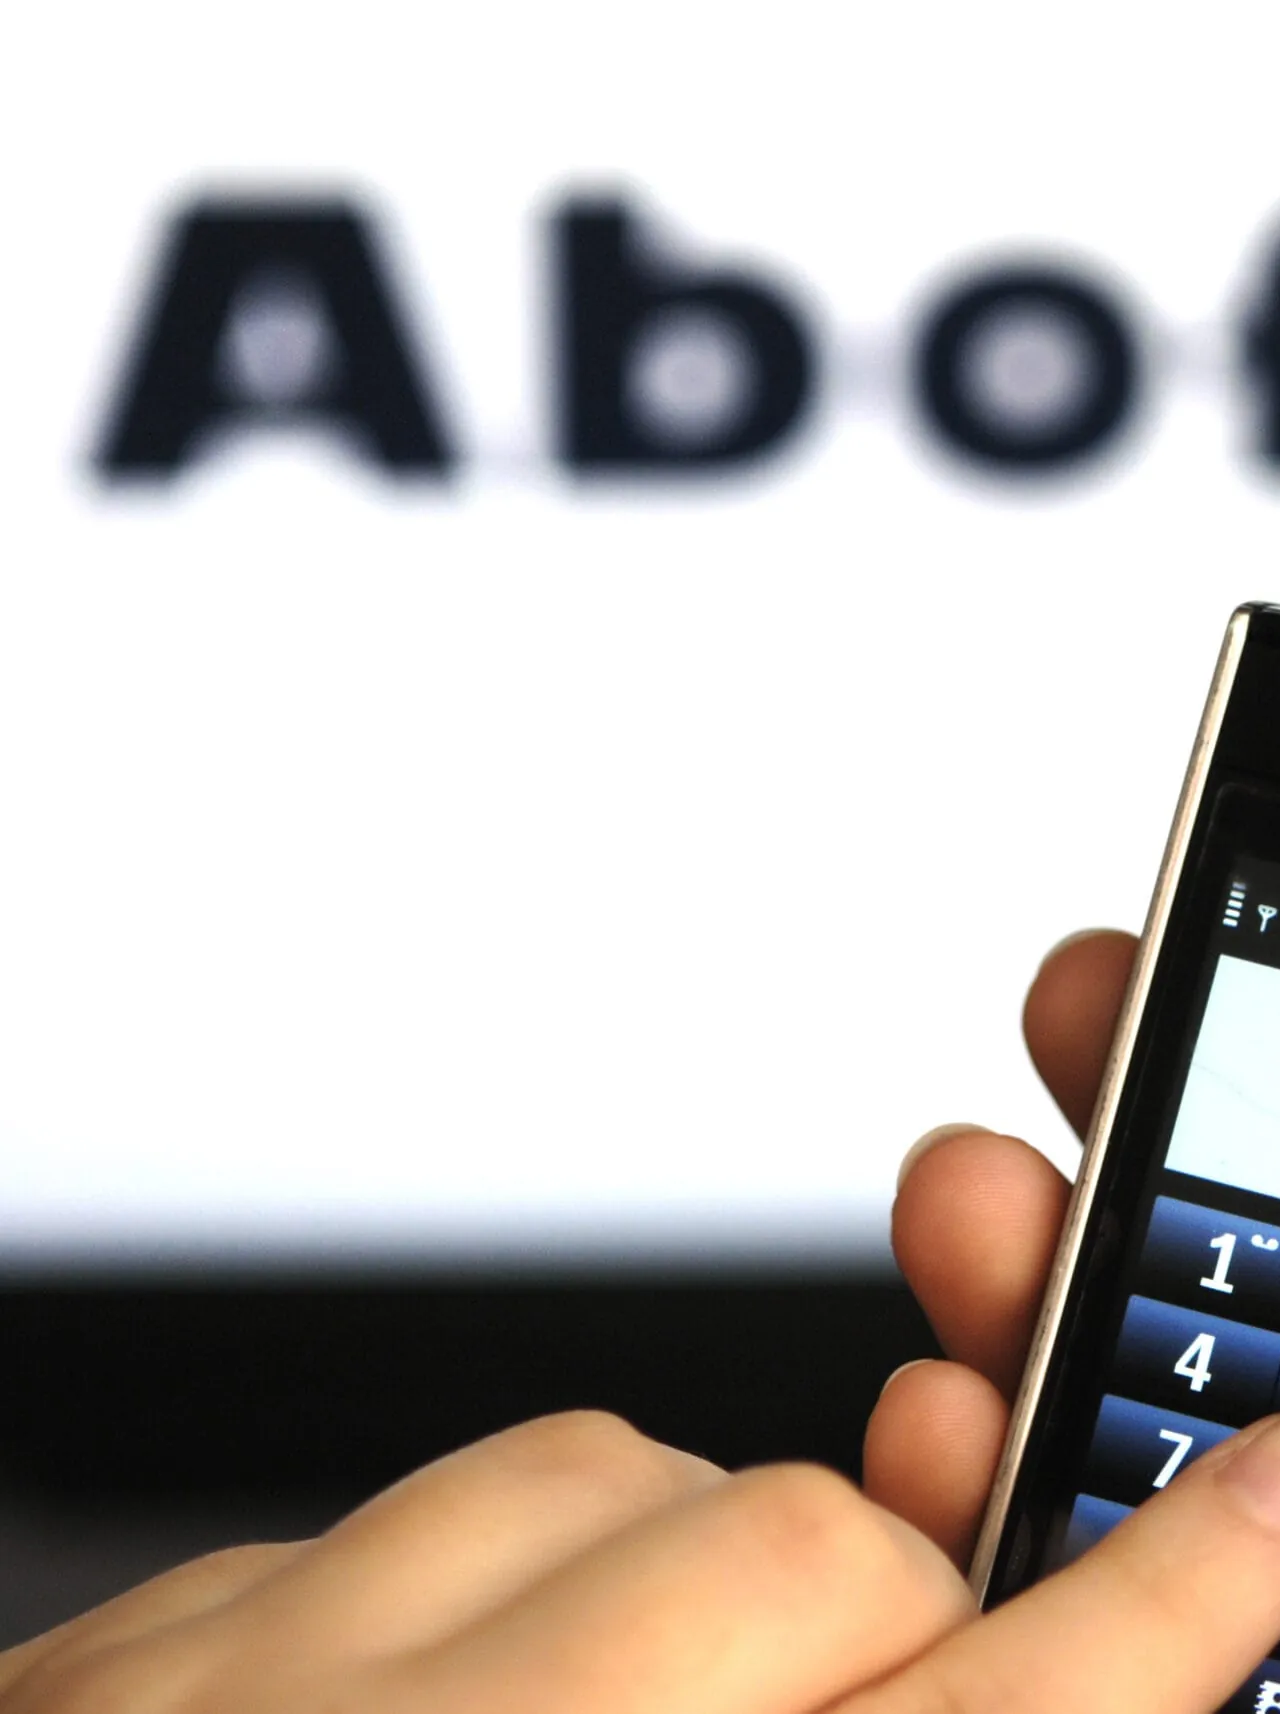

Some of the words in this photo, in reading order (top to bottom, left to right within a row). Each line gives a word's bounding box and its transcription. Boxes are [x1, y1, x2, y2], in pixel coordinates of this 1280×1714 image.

[1200, 1232, 1237, 1293] 1
[1174, 1332, 1216, 1392] 4
[1152, 1428, 1193, 1489] 7
